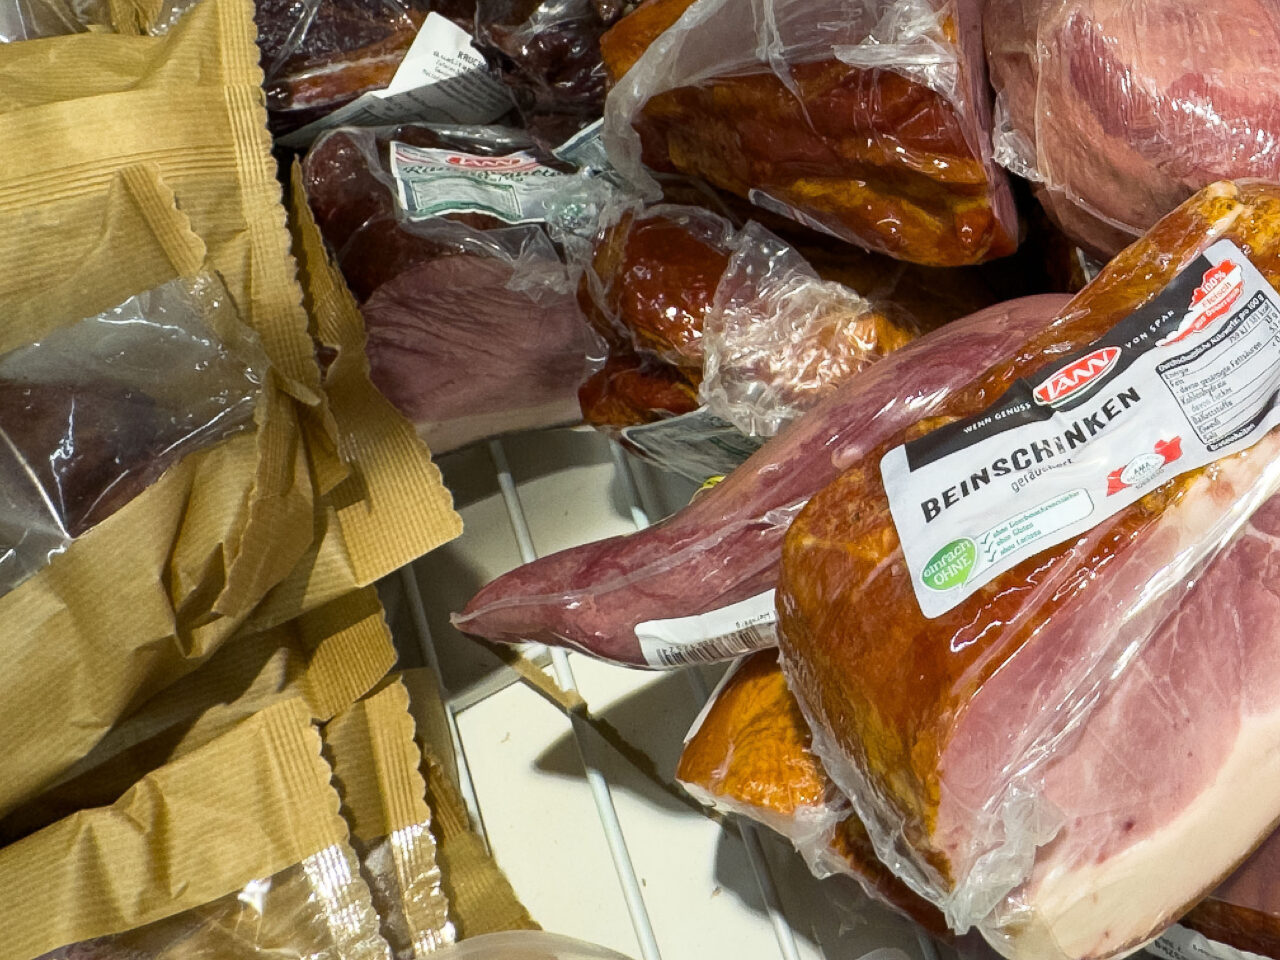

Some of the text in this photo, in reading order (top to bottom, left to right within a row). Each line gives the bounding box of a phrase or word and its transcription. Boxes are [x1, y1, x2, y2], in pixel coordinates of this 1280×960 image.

[1200, 270, 1226, 293] 100%
[1200, 280, 1231, 307] Fleisch
[1125, 310, 1175, 348] VON SPAR
[1047, 348, 1119, 402] TANN
[963, 401, 1031, 435] WENN GENUSS
[917, 386, 1141, 523] BEINSCHINKEN
[1131, 460, 1151, 476] AMA
[932, 553, 972, 585] OHNE
